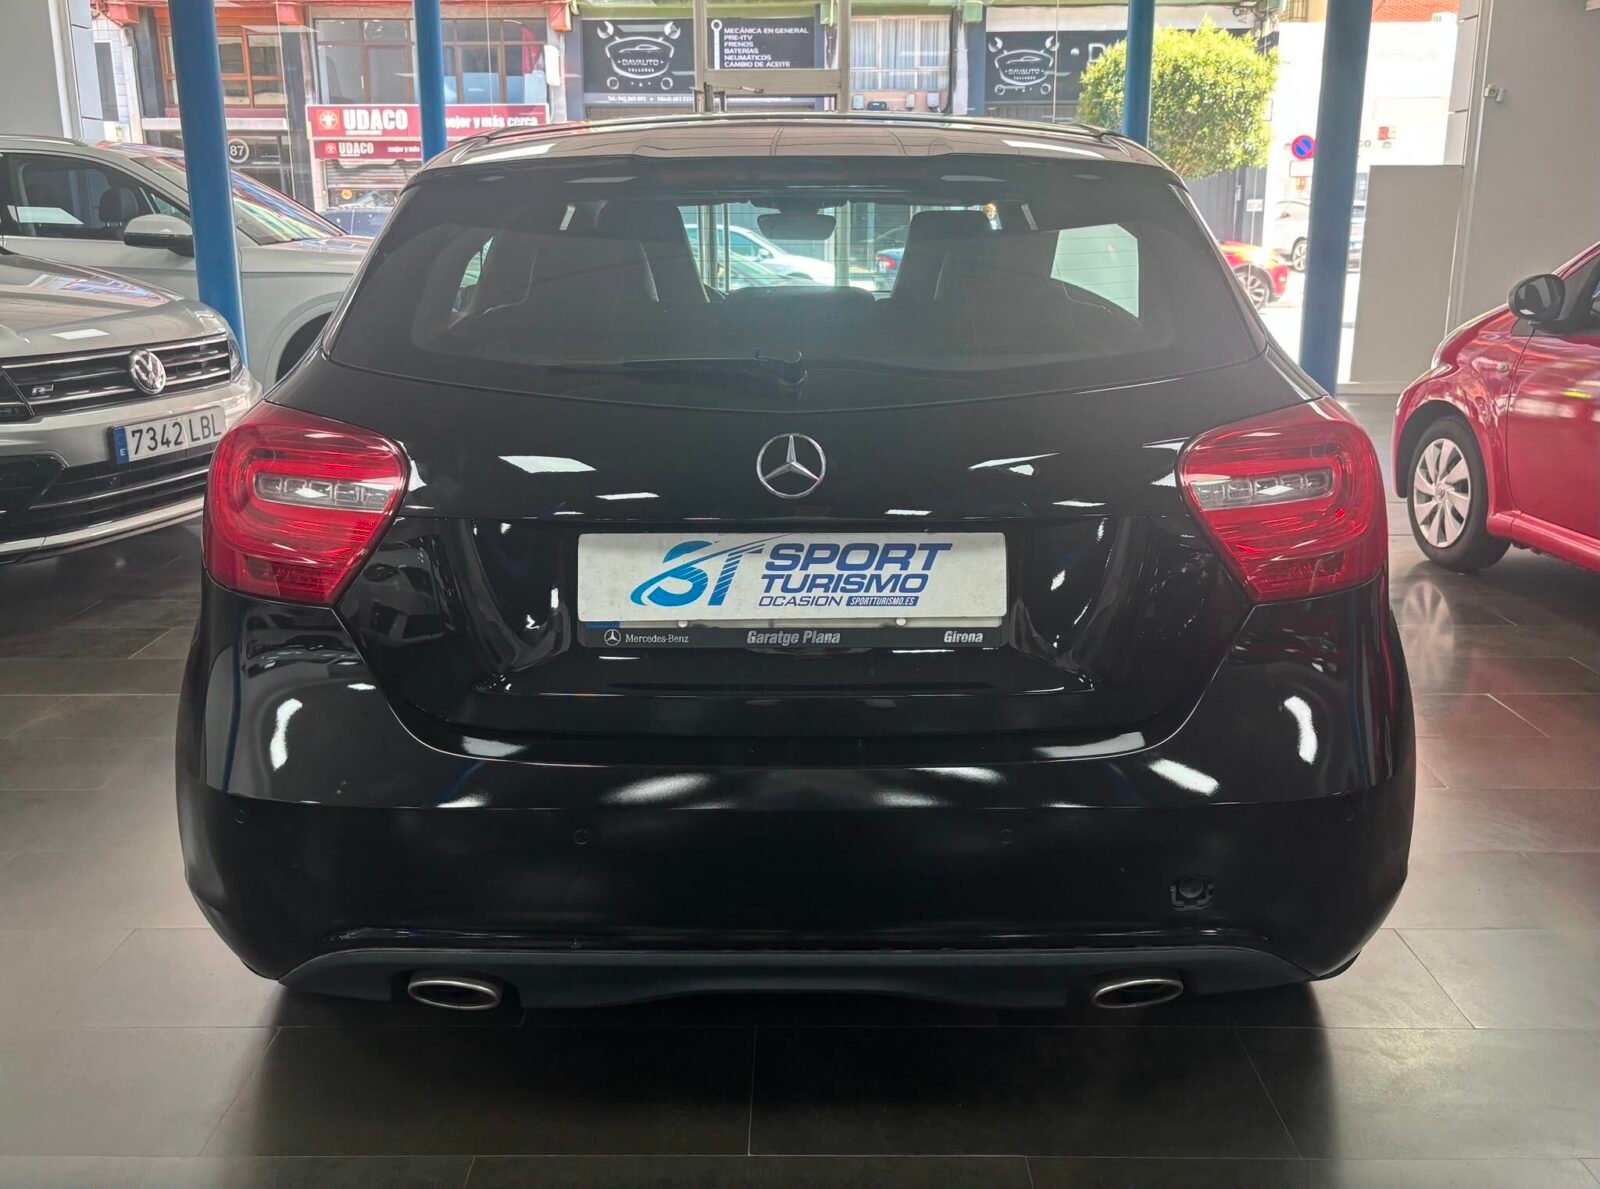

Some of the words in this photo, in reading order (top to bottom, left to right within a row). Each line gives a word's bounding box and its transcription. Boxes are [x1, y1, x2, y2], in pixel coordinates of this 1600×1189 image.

[342, 108, 408, 131] UDACO
[473, 117, 480, 129] y
[481, 115, 505, 128] más
[507, 117, 538, 126] cerca
[230, 145, 245, 156] 87
[338, 142, 375, 154] UDACO
[131, 421, 184, 455] 7342
[188, 413, 222, 442] LBL
[765, 543, 952, 571] SPORT
[761, 573, 929, 594] TURISMO
[758, 596, 844, 607] OCASION
[849, 596, 916, 607] SPORTTURISMO.ES
[625, 633, 690, 644] Mercedes-Benz
[746, 630, 799, 646] Garatge
[802, 630, 840, 644] Plana
[943, 631, 984, 643] Girona
